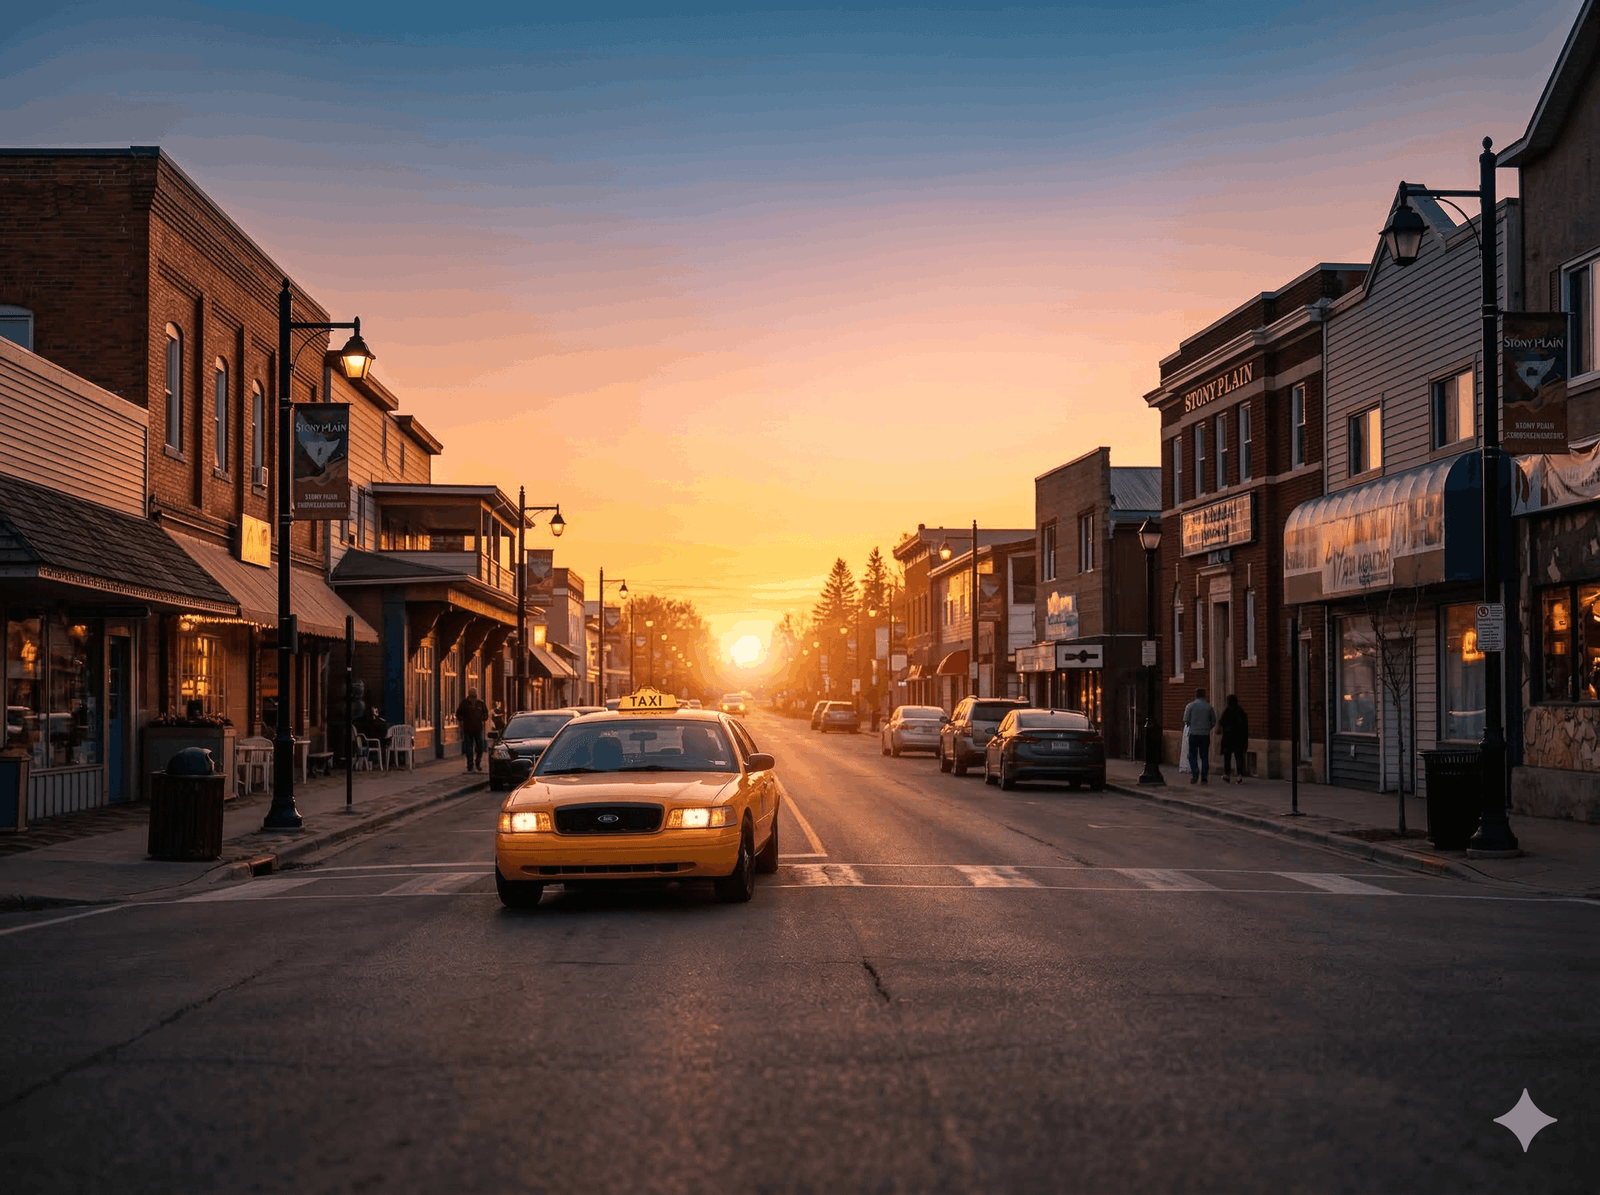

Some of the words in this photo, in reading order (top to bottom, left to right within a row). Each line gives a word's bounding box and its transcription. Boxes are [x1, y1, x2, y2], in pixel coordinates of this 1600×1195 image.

[1185, 381, 1217, 413] STONY
[1217, 362, 1253, 397] PLAIN
[630, 695, 662, 707] TAXI
